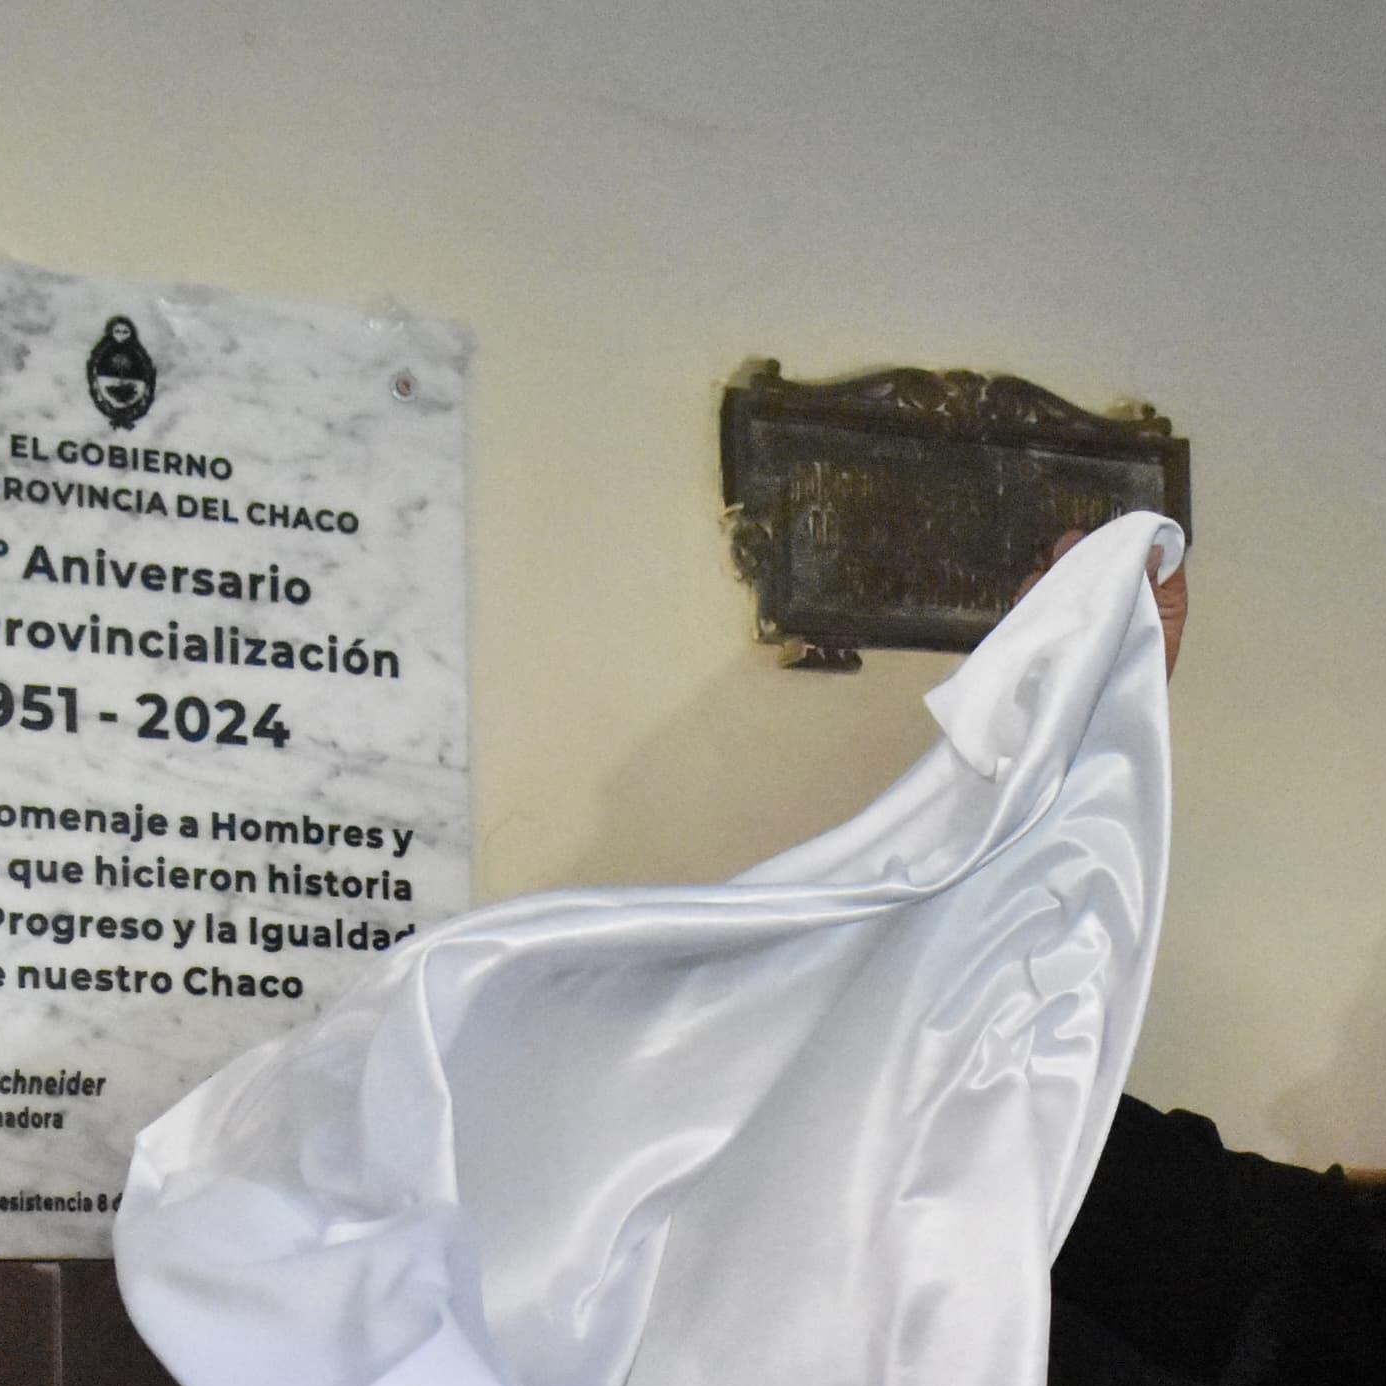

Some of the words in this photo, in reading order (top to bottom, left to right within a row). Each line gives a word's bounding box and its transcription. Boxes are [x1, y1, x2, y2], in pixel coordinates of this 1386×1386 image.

[10, 433, 51, 464] EL
[55, 440, 233, 481] GOBIERNO
[176, 494, 239, 524] DEL
[246, 501, 360, 535] CHACO
[22, 544, 312, 606] Aniversario
[99, 711, 118, 723] -
[136, 693, 291, 749] 2024
[178, 815, 199, 839] a
[211, 811, 384, 850] Hombres
[391, 827, 414, 859] y
[7, 858, 84, 889] que
[95, 855, 257, 893] hicieron
[267, 863, 413, 902] historia
[172, 918, 196, 950] y
[205, 912, 237, 945] la
[18, 965, 173, 995] nuestro
[182, 966, 304, 1000] Chaco
